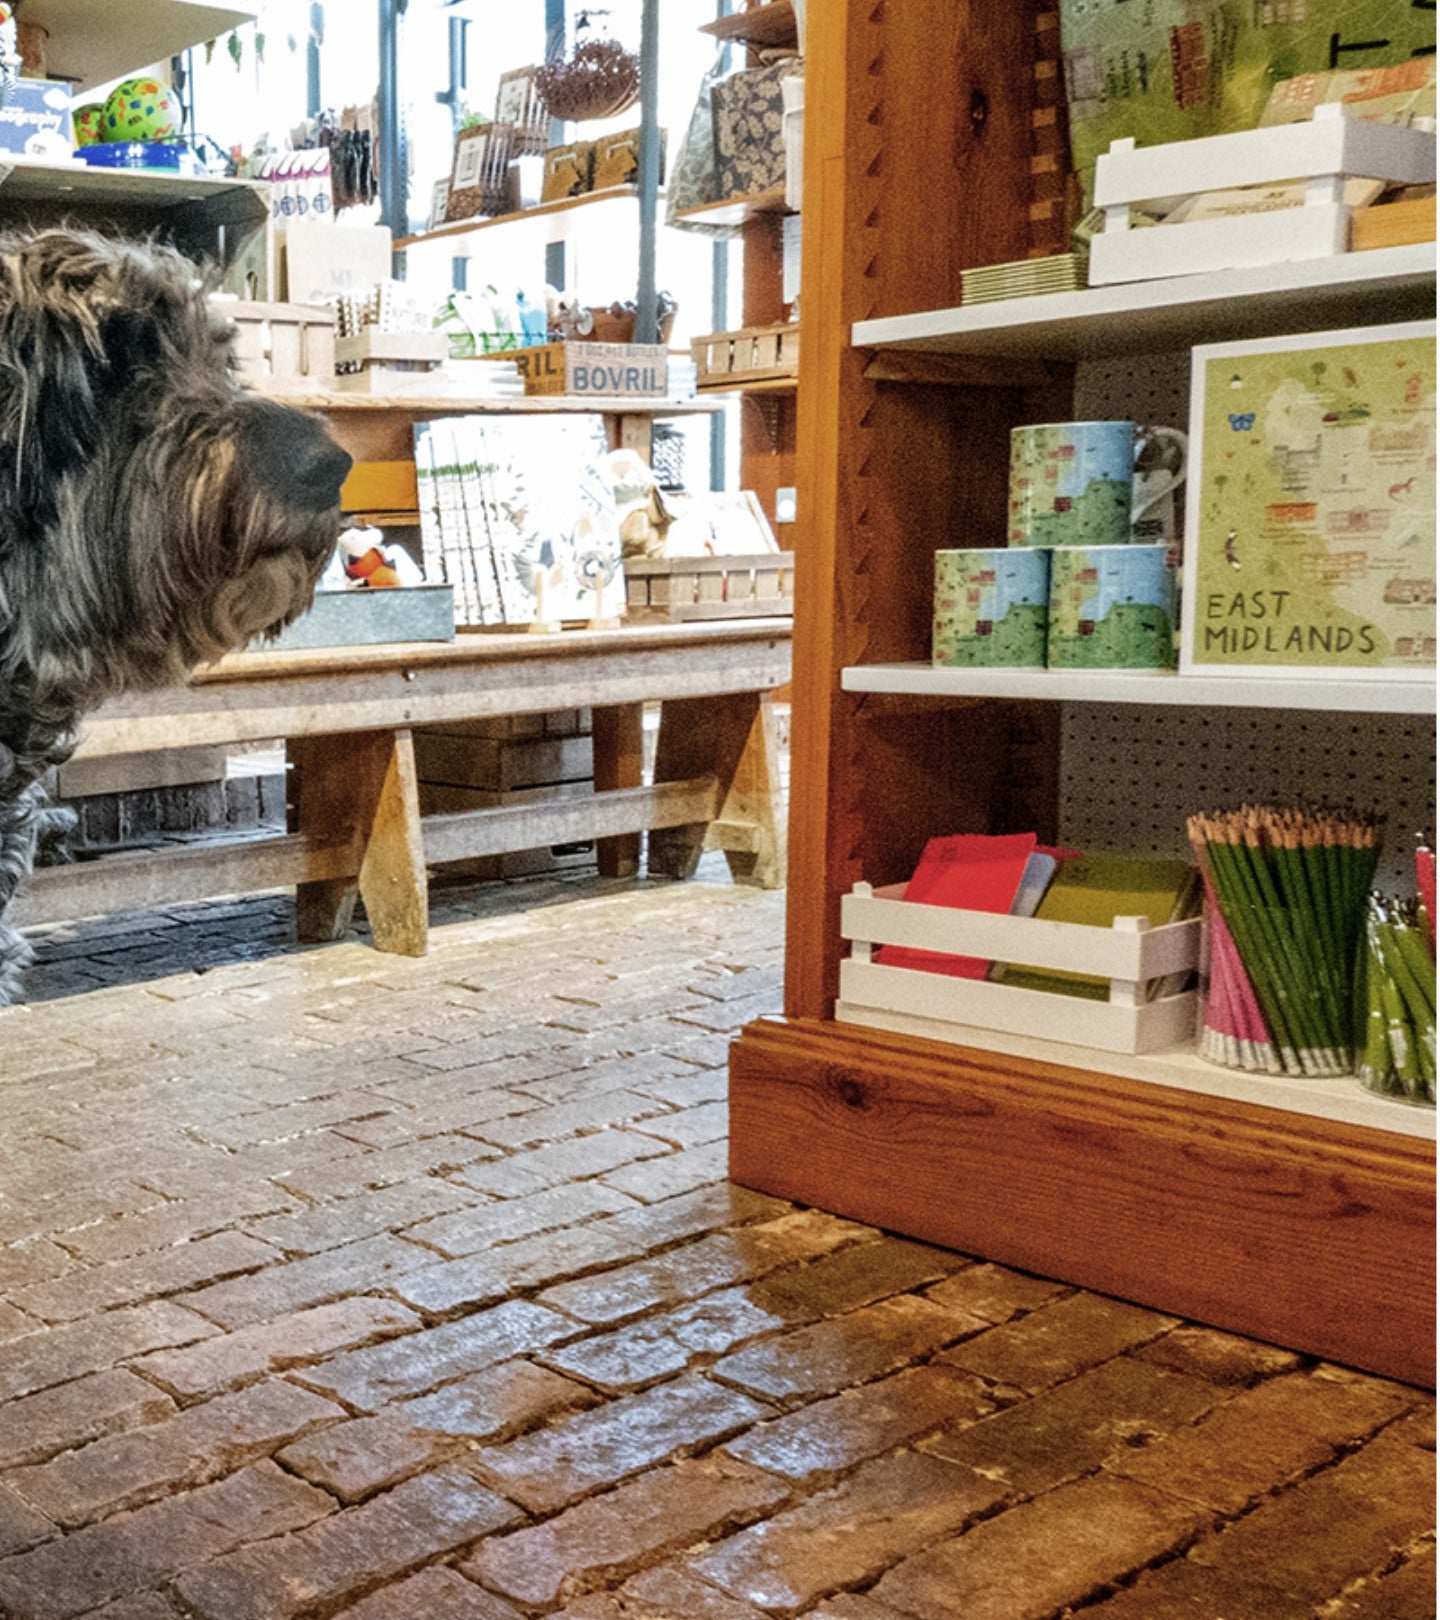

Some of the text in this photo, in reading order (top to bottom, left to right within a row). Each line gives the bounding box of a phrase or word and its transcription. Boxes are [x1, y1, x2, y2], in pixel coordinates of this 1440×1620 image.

[514, 351, 557, 378] RIL
[573, 366, 663, 391] BOVRIL
[1207, 590, 1290, 619] EAST
[1204, 624, 1375, 654] MIDLANDS
